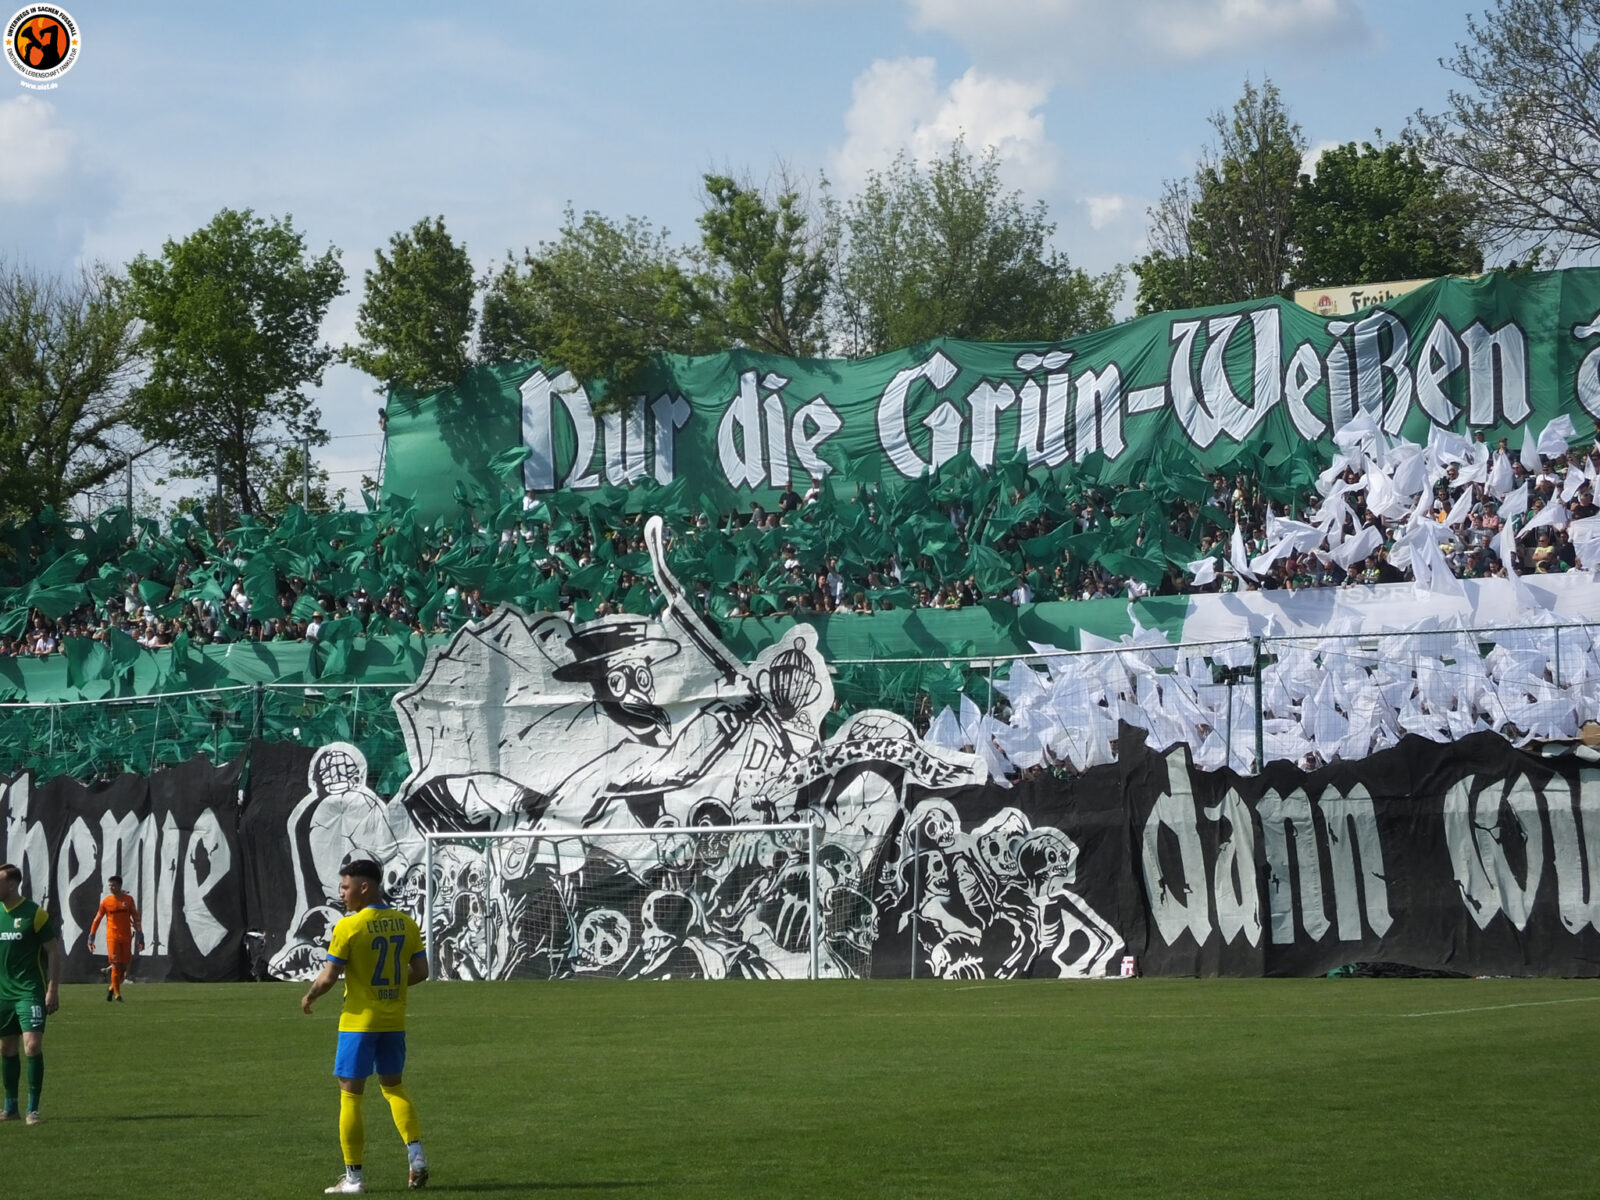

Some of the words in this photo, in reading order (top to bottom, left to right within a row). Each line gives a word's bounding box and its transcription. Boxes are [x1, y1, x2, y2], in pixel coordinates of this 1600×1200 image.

[518, 368, 692, 491] Nur
[716, 366, 845, 489] die
[0, 771, 232, 958] hemie
[1141, 746, 1396, 949] dann
[366, 918, 406, 934] LEIPZIG
[370, 934, 406, 987] 27
